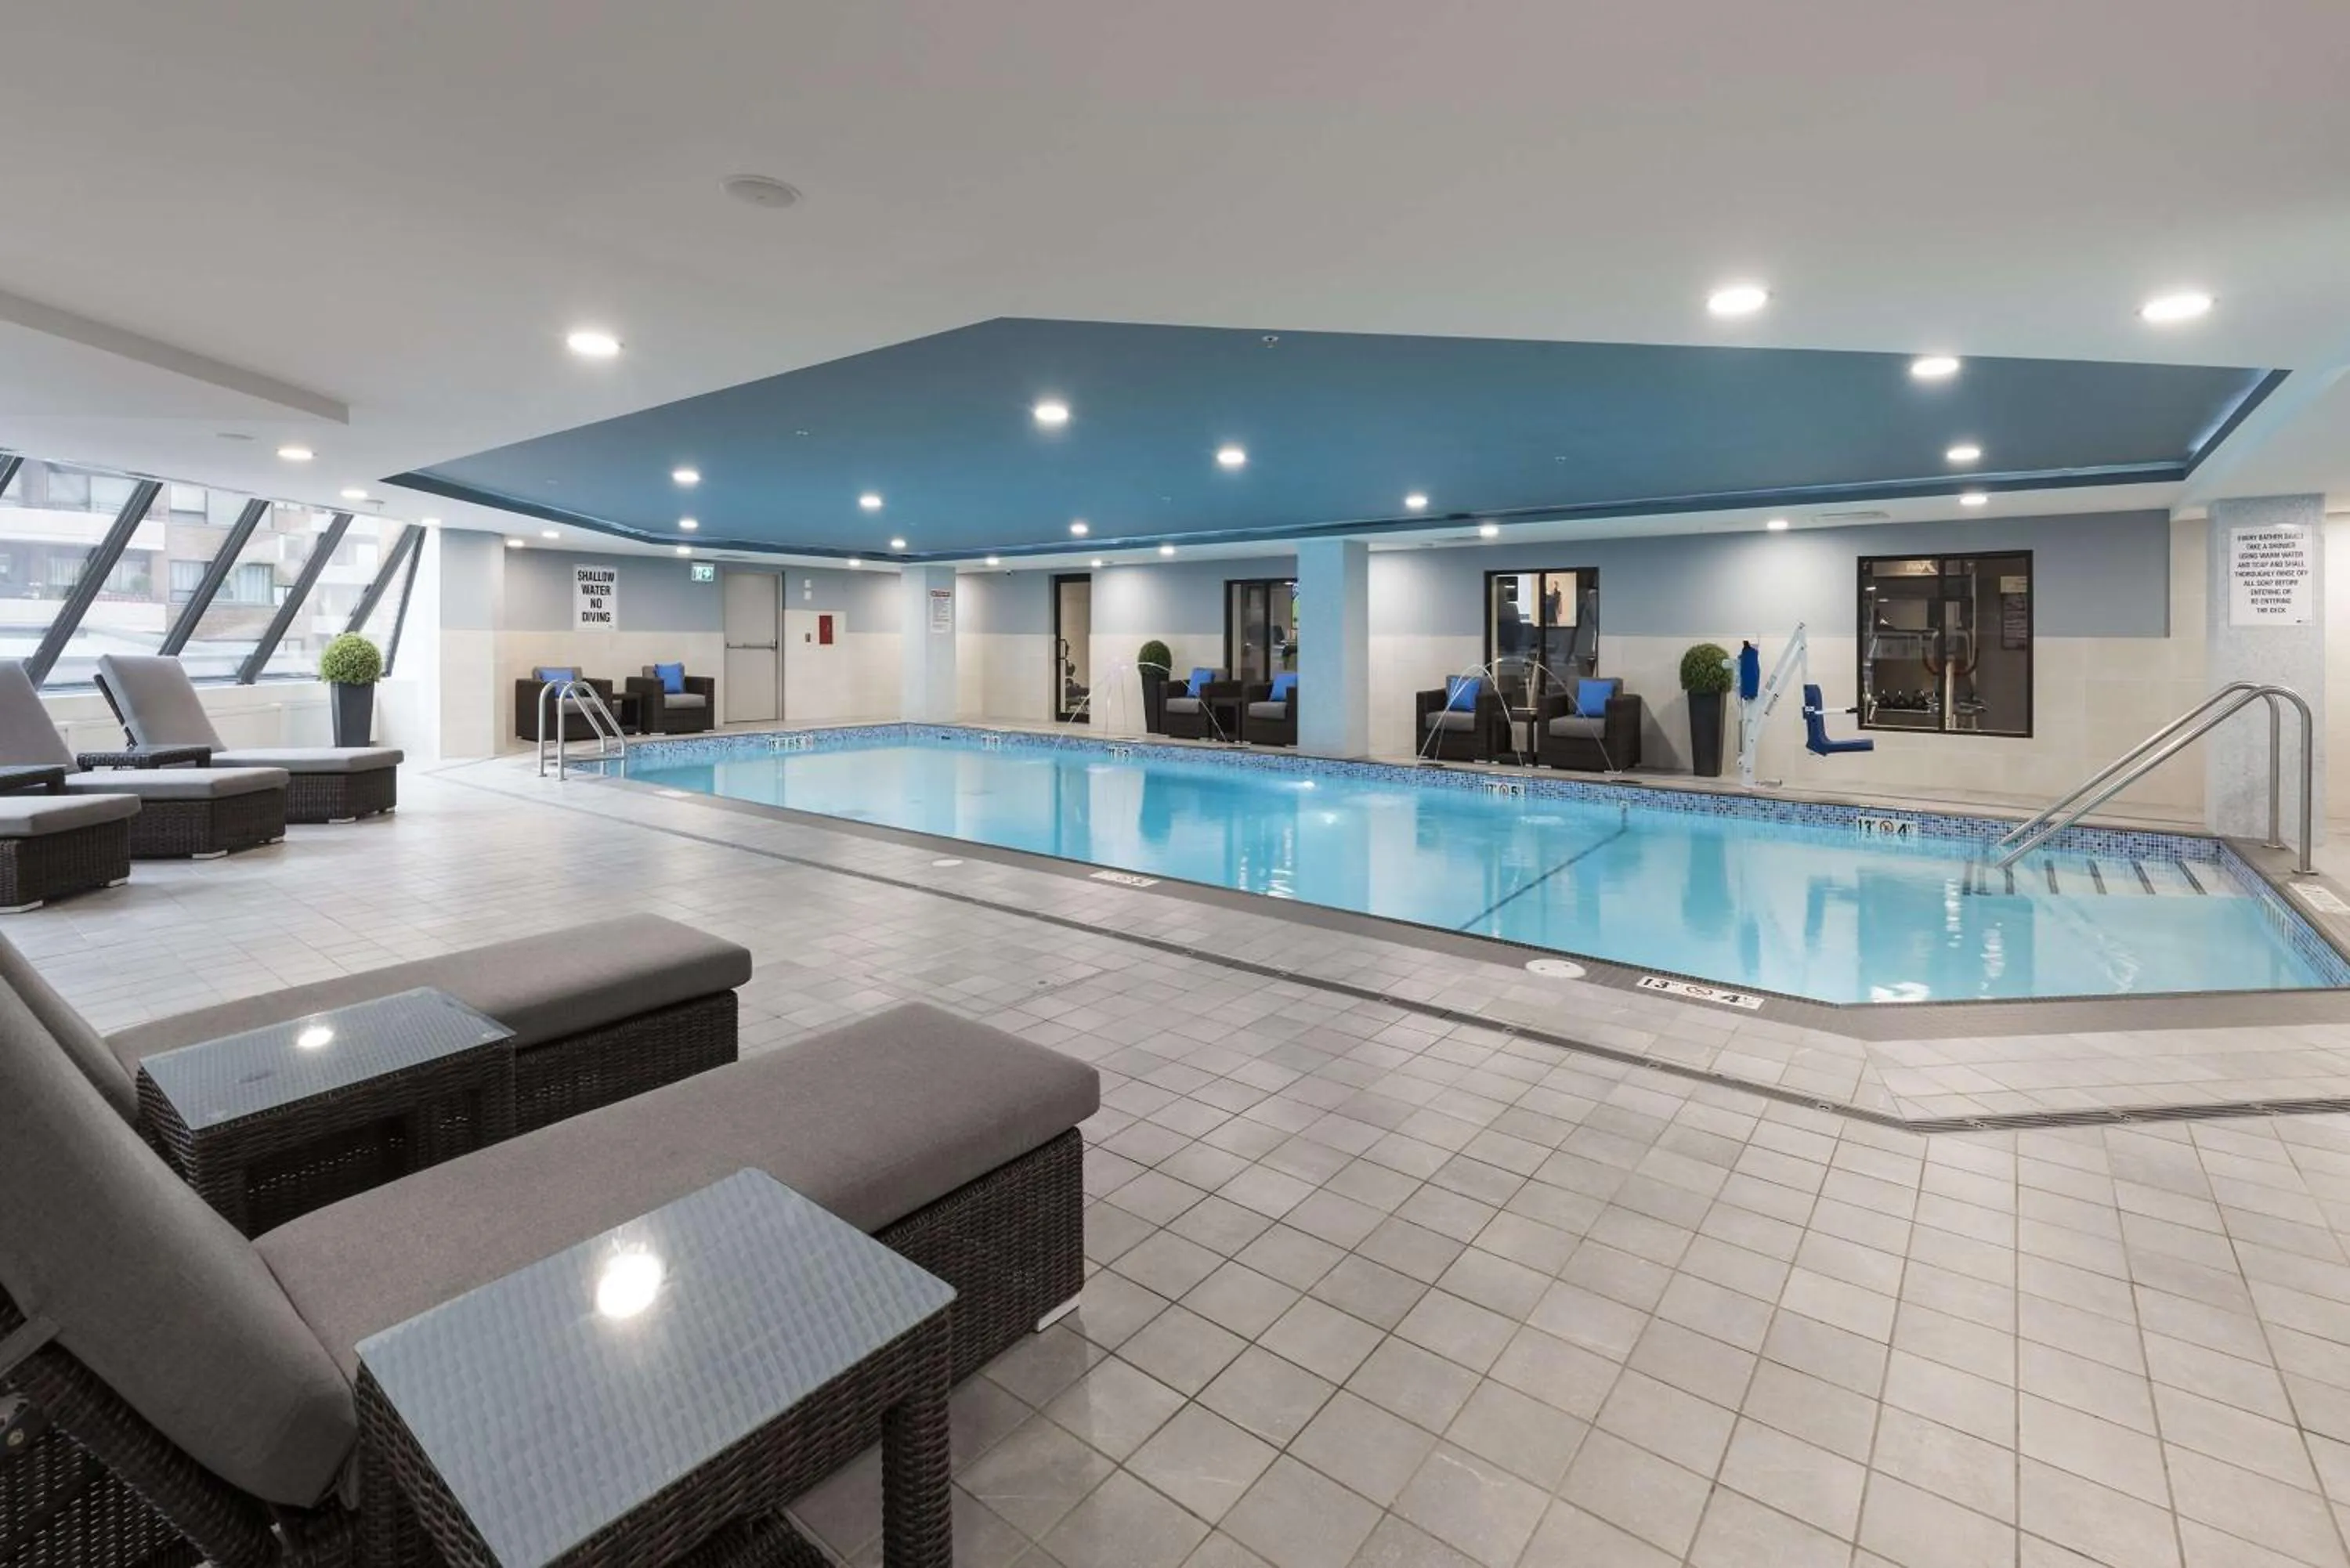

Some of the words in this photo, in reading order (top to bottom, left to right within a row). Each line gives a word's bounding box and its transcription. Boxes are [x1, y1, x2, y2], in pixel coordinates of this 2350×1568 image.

[577, 570, 615, 582] SHALLOW
[581, 584, 612, 595] WATER
[590, 598, 602, 609] NO
[582, 612, 610, 622] DIVING
